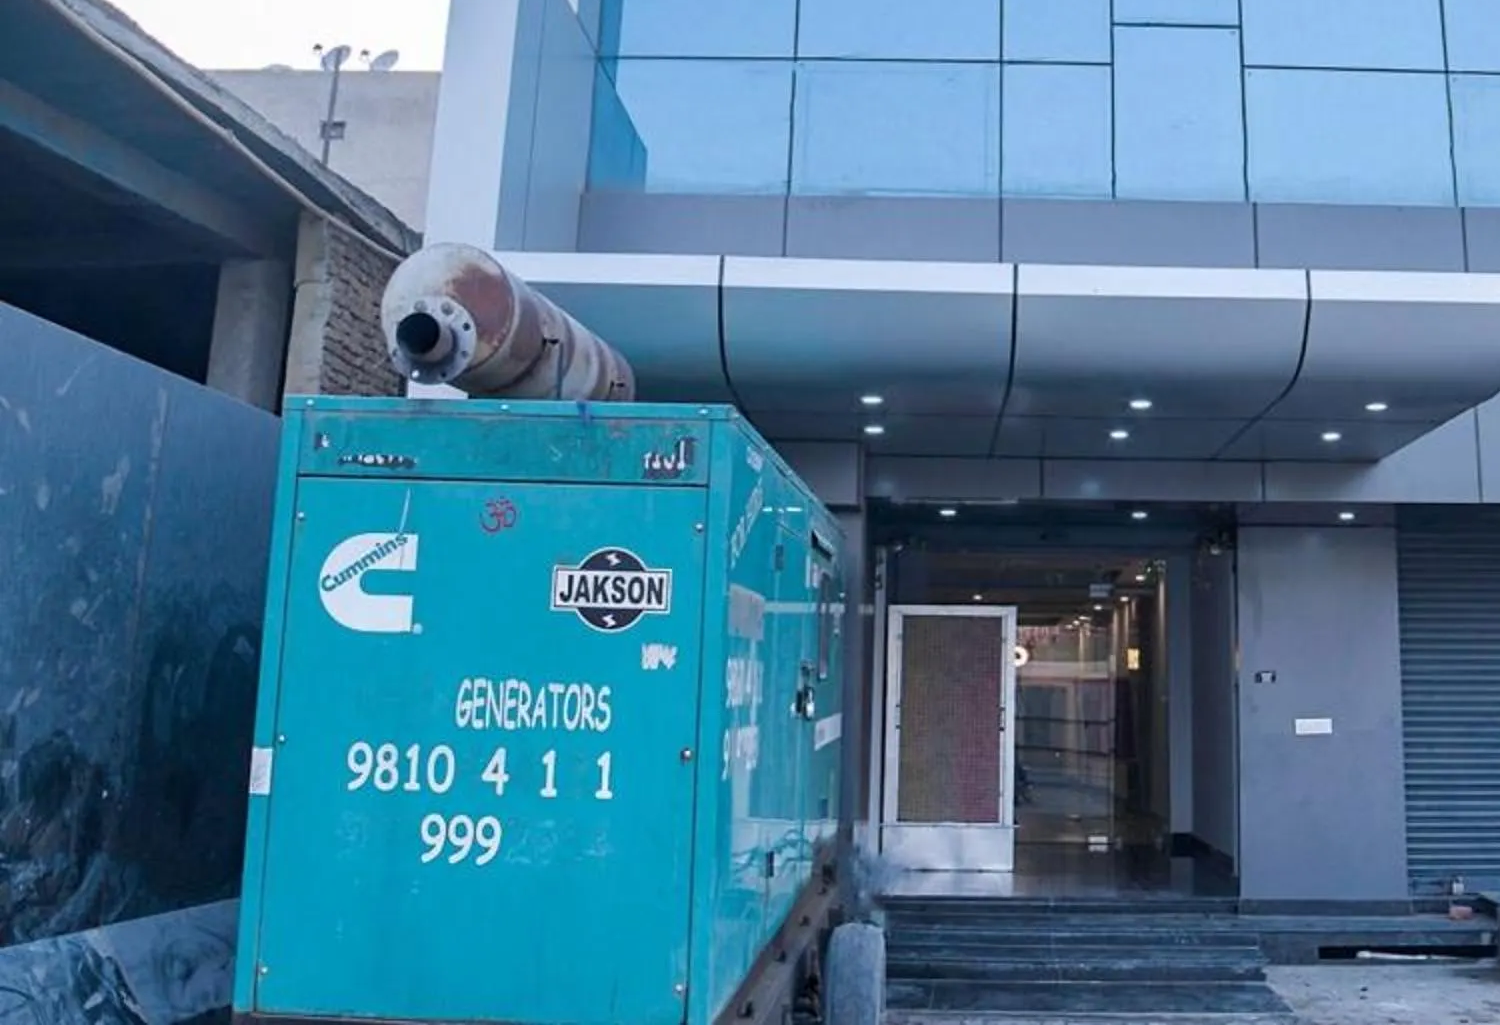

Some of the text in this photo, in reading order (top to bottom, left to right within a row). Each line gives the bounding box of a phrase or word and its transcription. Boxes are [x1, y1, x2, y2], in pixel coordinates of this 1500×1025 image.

[320, 532, 408, 593] Cummins
[558, 574, 665, 607] JAKSON
[455, 677, 612, 732] GENERATORS
[347, 741, 613, 800] 9810 4 1 1
[420, 813, 503, 867] 999
